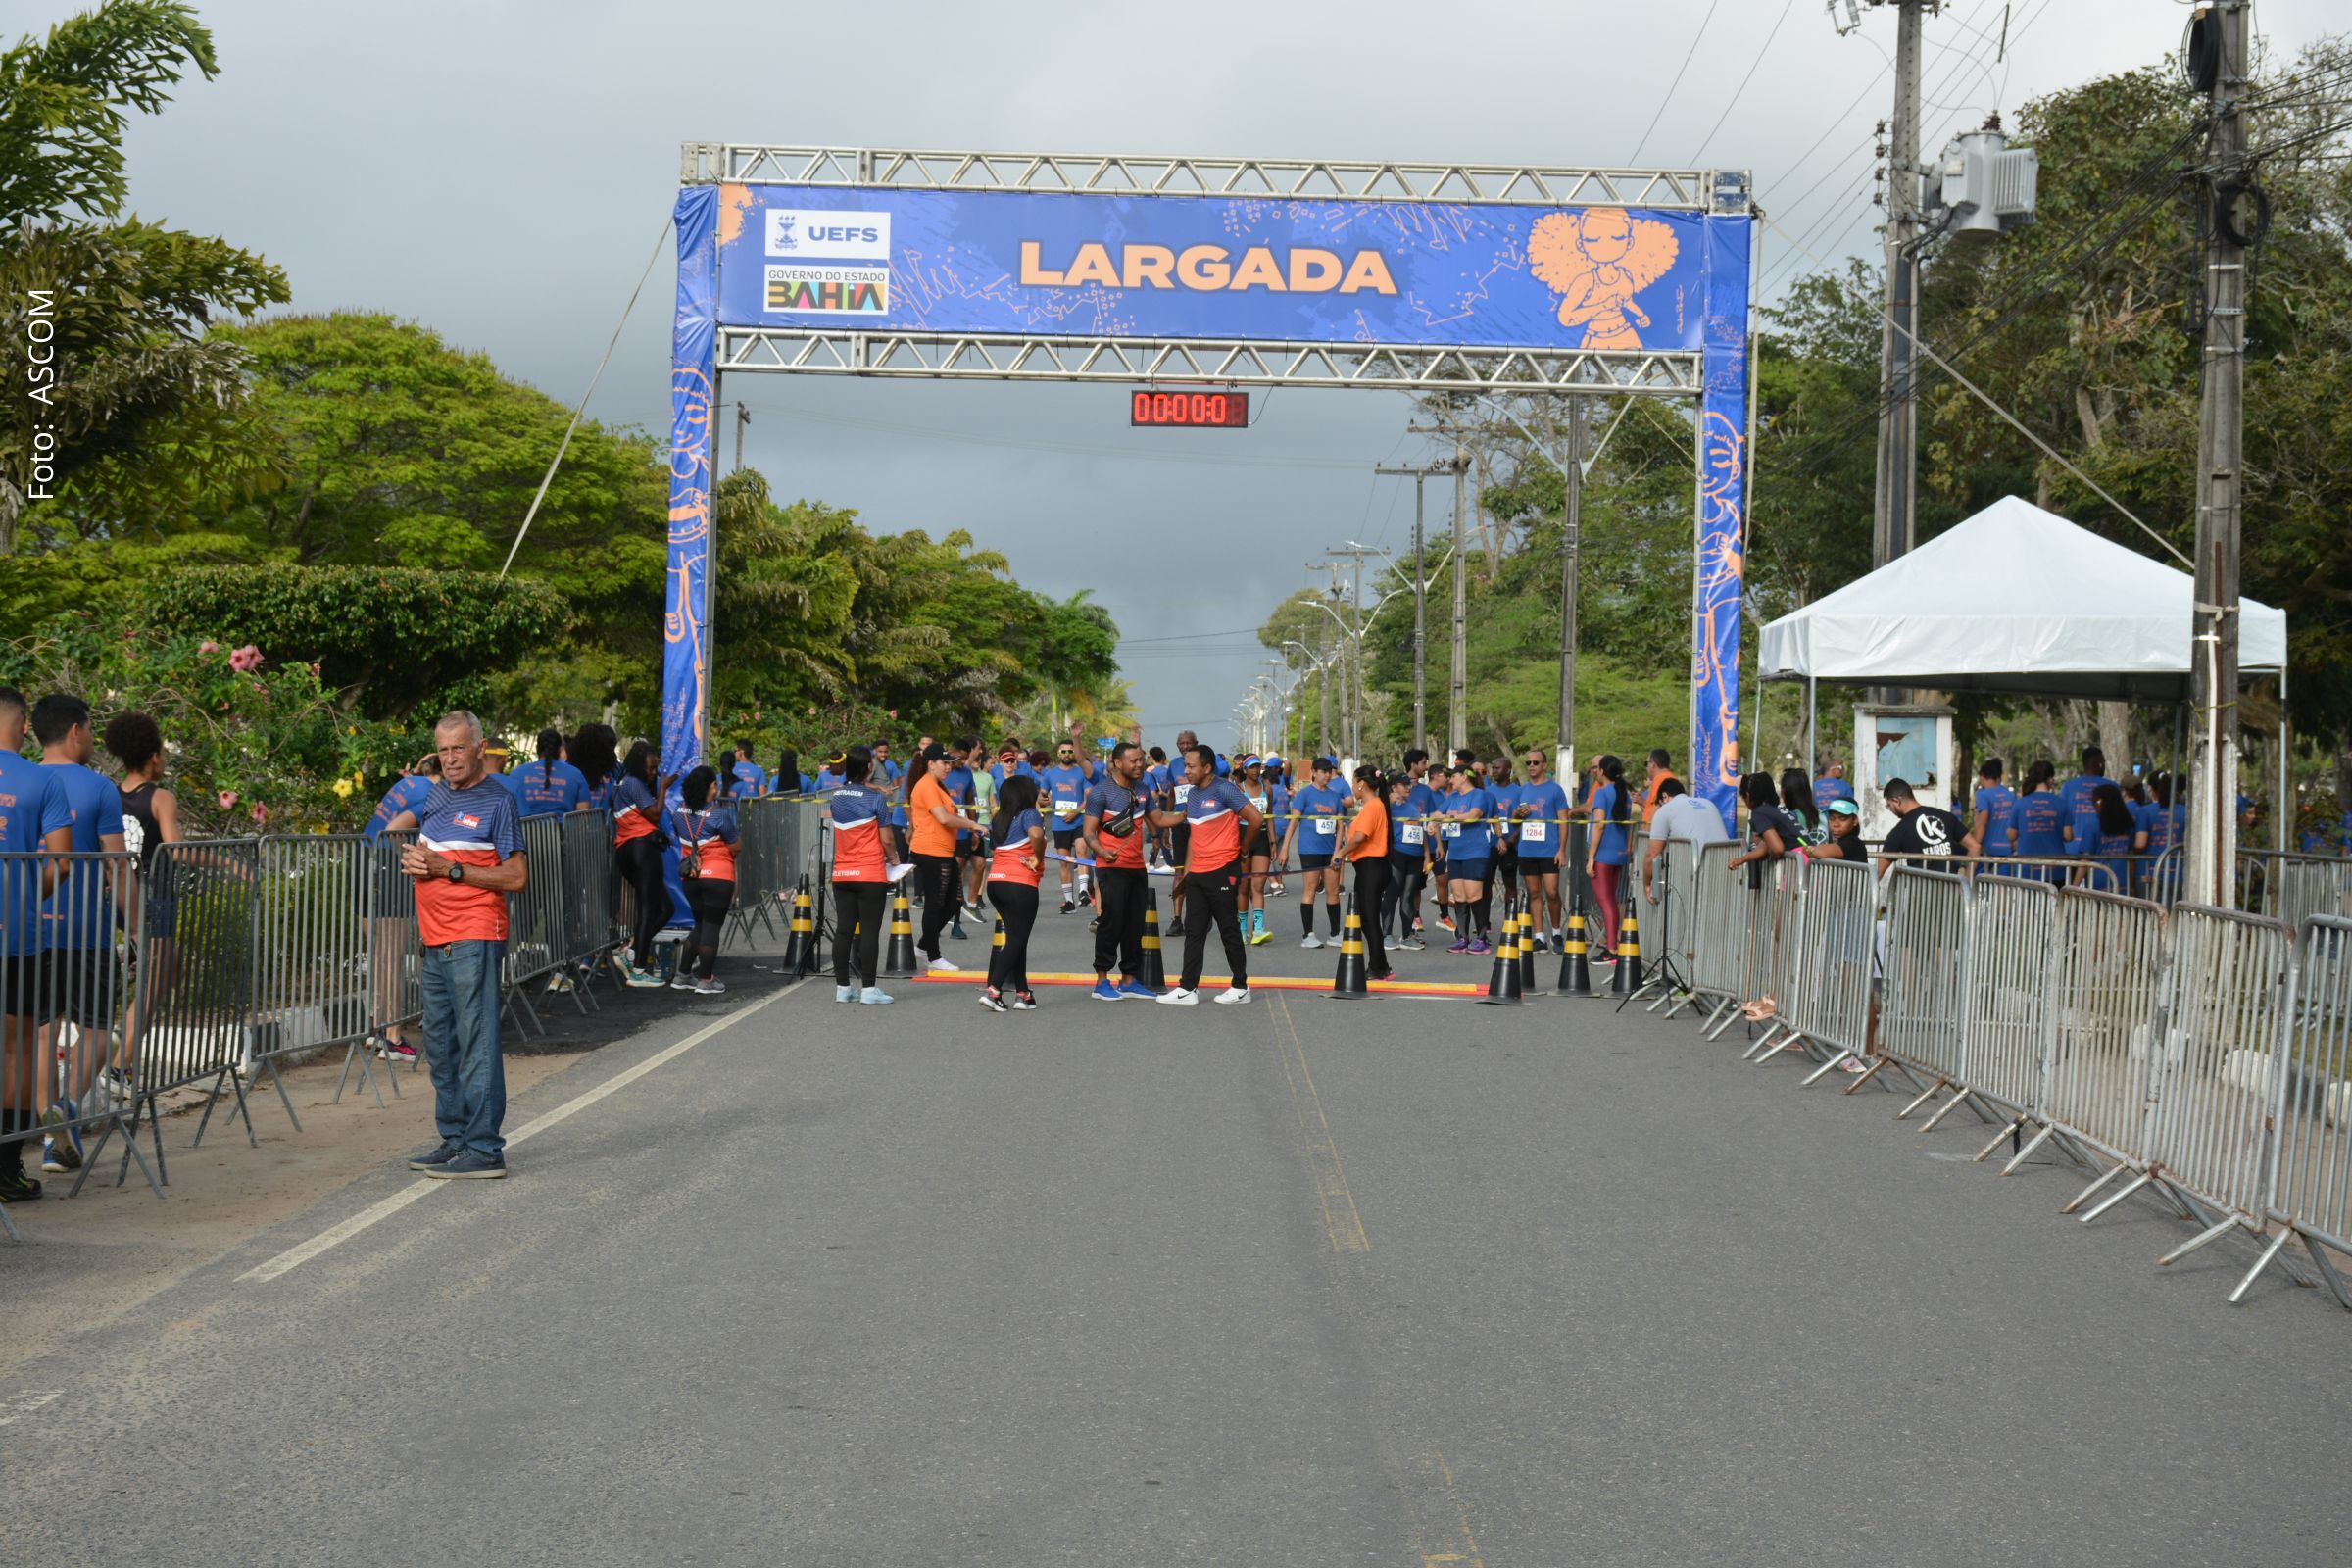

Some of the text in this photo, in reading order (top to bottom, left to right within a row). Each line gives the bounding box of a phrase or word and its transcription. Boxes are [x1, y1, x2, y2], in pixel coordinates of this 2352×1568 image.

[808, 226, 878, 243] UEFS
[1020, 242, 1397, 294] LARGADA
[768, 270, 885, 282] GOVERNO DO ESTADO
[767, 280, 884, 311] BAHIA
[1321, 821, 1334, 830] 457
[1408, 830, 1421, 840] 456
[1526, 828, 1543, 837] 1284
